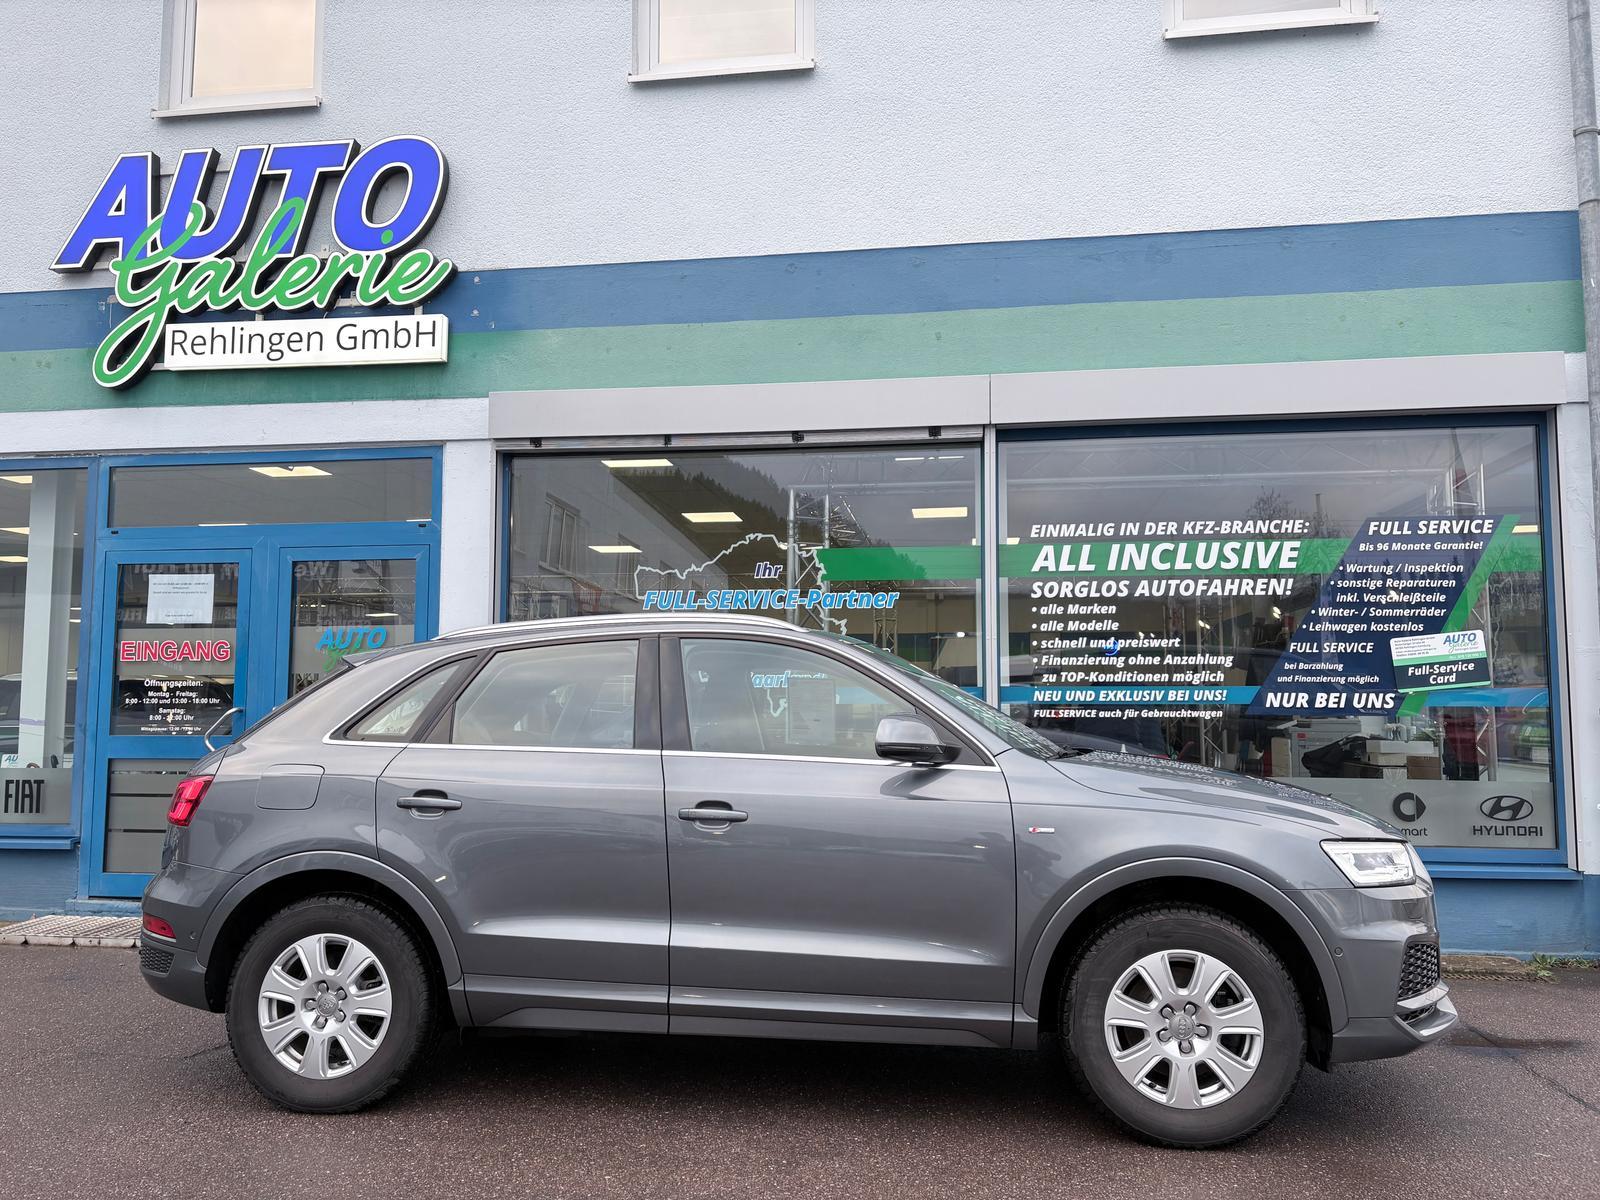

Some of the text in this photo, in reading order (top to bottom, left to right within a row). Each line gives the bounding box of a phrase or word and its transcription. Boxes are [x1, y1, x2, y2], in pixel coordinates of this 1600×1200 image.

[52, 134, 446, 271] AUTO
[92, 197, 455, 388] Galerie
[170, 319, 436, 361] Rehlingen GmbH
[1030, 519, 1310, 538] EINMALIG IN DER KFZ-BRANCHE:
[1368, 519, 1494, 535] FULL SERVICE
[1359, 541, 1483, 551] Bis 96 Monate Garantie!
[1031, 541, 1301, 572] ALL INCLUSIVE
[754, 561, 783, 579] Ihr
[1346, 563, 1393, 575] Wartung
[1404, 563, 1464, 575] Inspektion
[1031, 578, 1294, 598] SORGLOS AUTOFAHREN!
[1337, 578, 1456, 589] sonstige Reparaturen
[643, 588, 900, 610] FULL-SERVICE-Partner
[1336, 592, 1446, 603] inkl. Verschleißteile
[1040, 604, 1117, 615] alle Marken
[1318, 607, 1359, 617] Winter-
[1369, 607, 1446, 617] Sommerräder
[1040, 620, 1119, 631] alle Modelle
[1309, 621, 1424, 633] Leihwagen kostenlos
[315, 626, 387, 650] AUTO
[1040, 637, 1181, 651] schnell und preiswert
[1443, 633, 1477, 645] AUTO
[120, 640, 230, 662] EINGANG
[1290, 642, 1374, 653] FULL SERVICE
[1041, 654, 1234, 668] Finanzierung ohne Anzahlung
[1284, 662, 1344, 671] bei Barzahlung
[1408, 661, 1475, 676] Full-Service
[144, 679, 203, 688] Öffnungszeiten:
[1042, 670, 1225, 685] zu TOP-Konditionen möglich
[1277, 675, 1379, 684] und Finanzierung möglich
[1429, 673, 1456, 684] Card
[1033, 689, 1227, 701] NEU UND EXKLUSIV BEI UNS!
[1265, 692, 1396, 709] NUR BEI UNS
[1033, 708, 1223, 720] FULL SERVICE auch für Gebrauchtwagen
[4, 779, 44, 813] FIAT
[1401, 827, 1428, 836] mart
[1473, 825, 1543, 836] HYUNDAI
